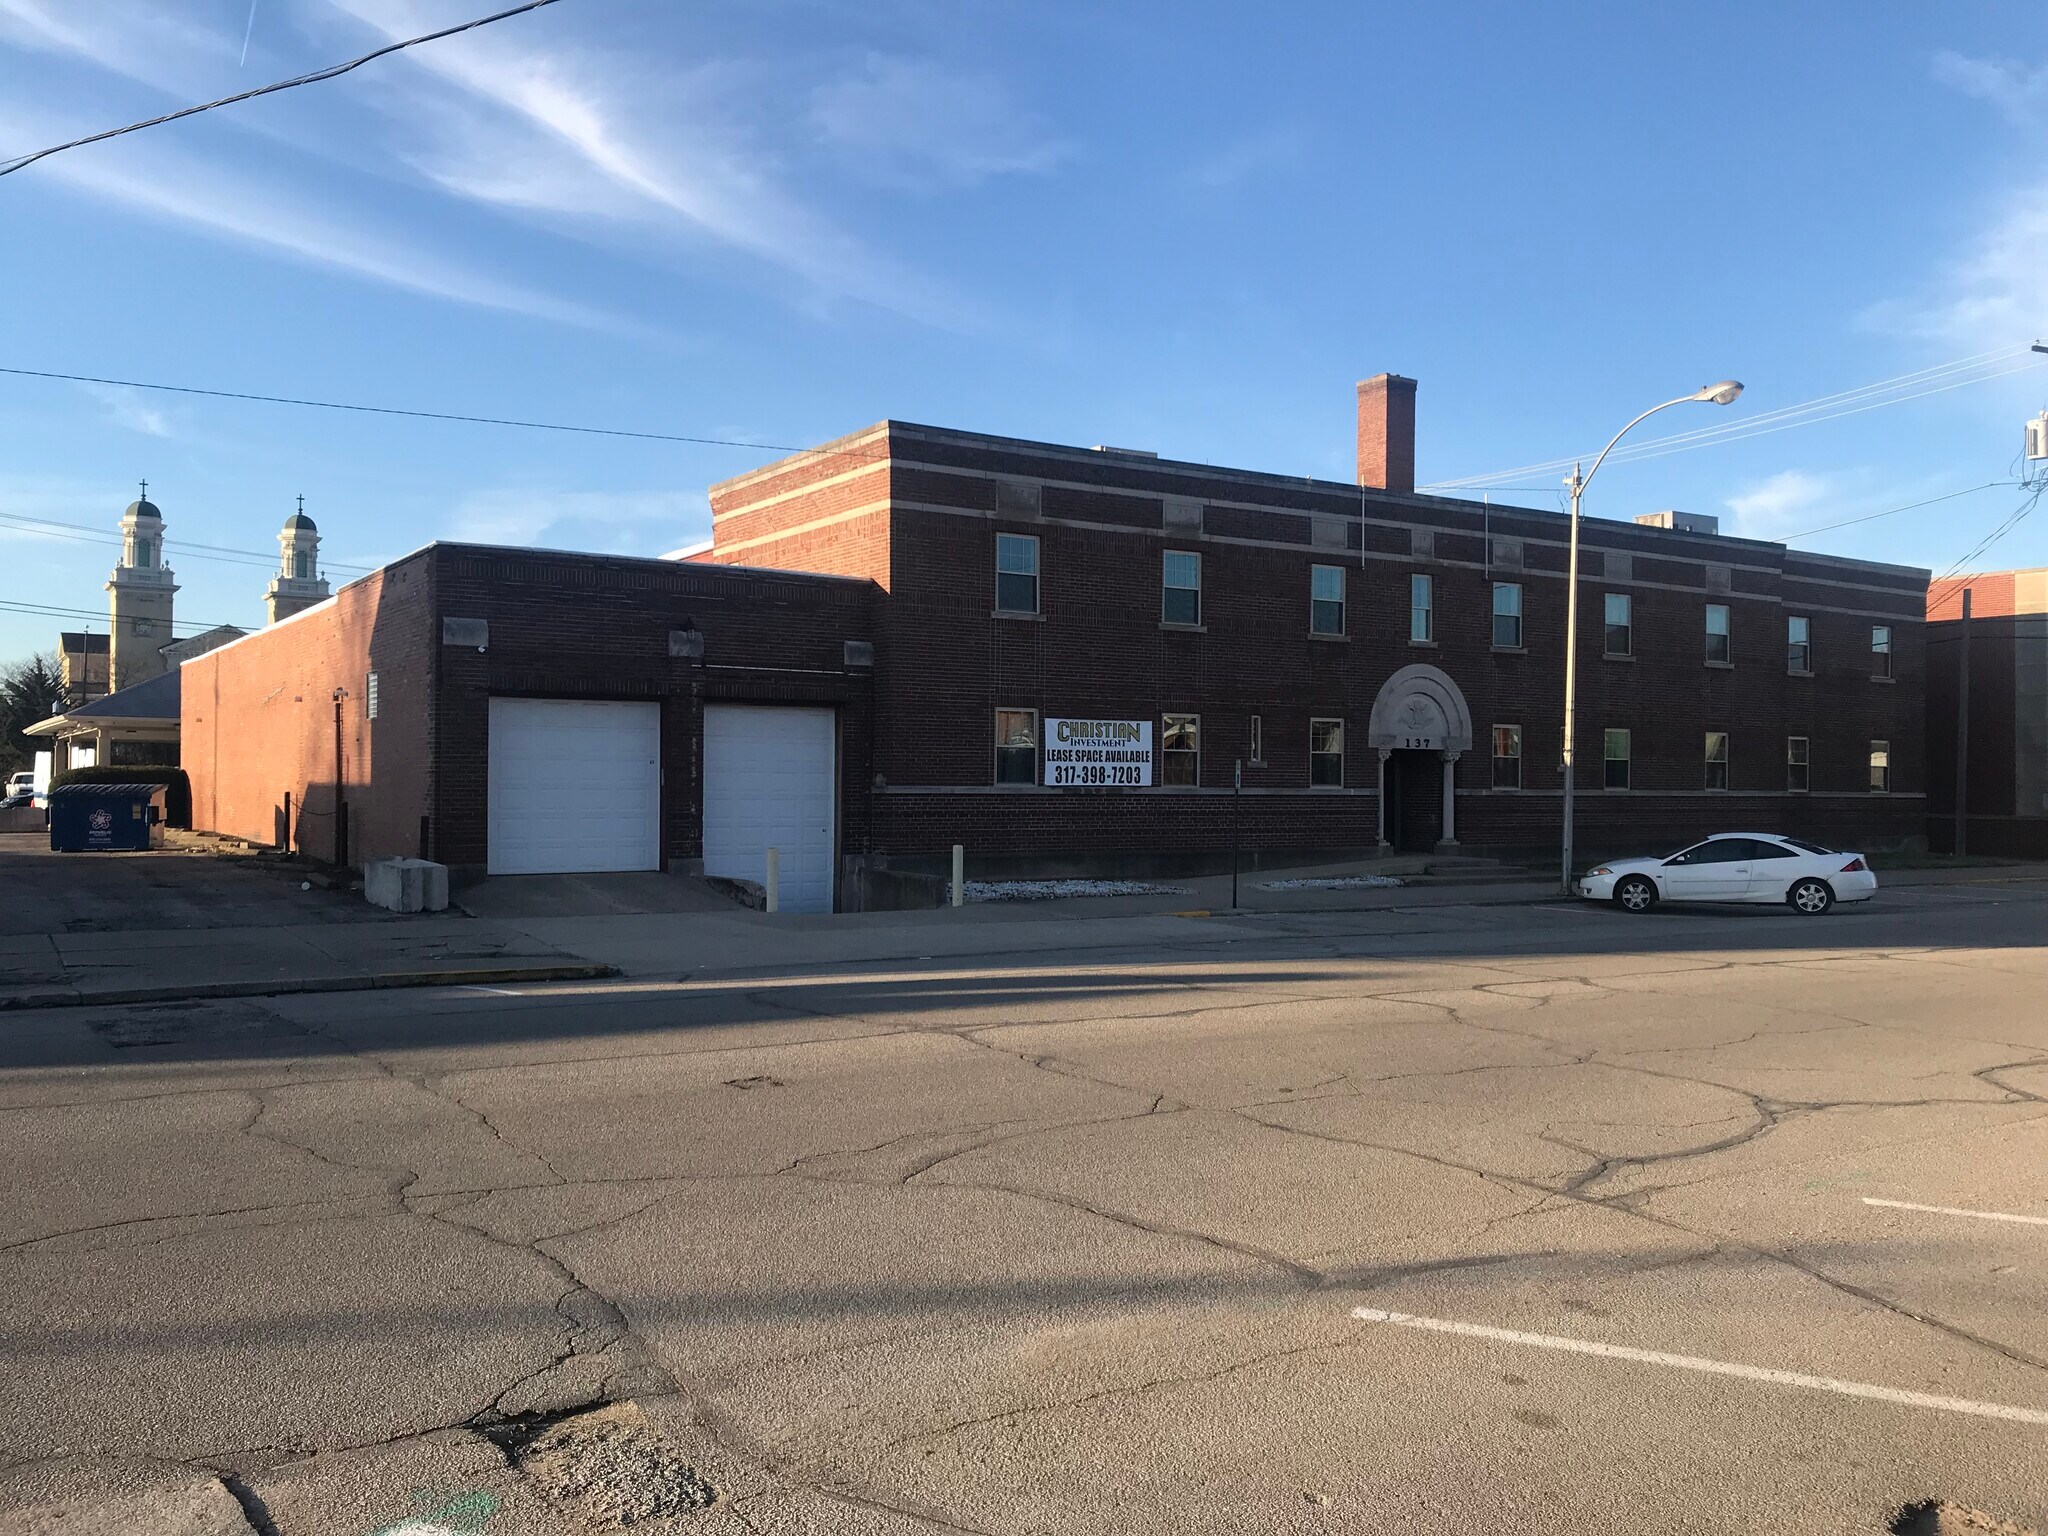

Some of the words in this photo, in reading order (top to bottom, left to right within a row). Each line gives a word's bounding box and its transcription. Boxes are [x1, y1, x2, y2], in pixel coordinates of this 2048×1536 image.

[1057, 721, 1141, 742] CHRISTIAN
[1070, 738, 1126, 747] INVESTMENT
[1405, 738, 1430, 748] 137
[1047, 749, 1073, 762] LEASE
[1075, 749, 1103, 762] SPACE
[1105, 750, 1150, 763] AVAILABLE
[1055, 765, 1141, 784] 317-398-7203
